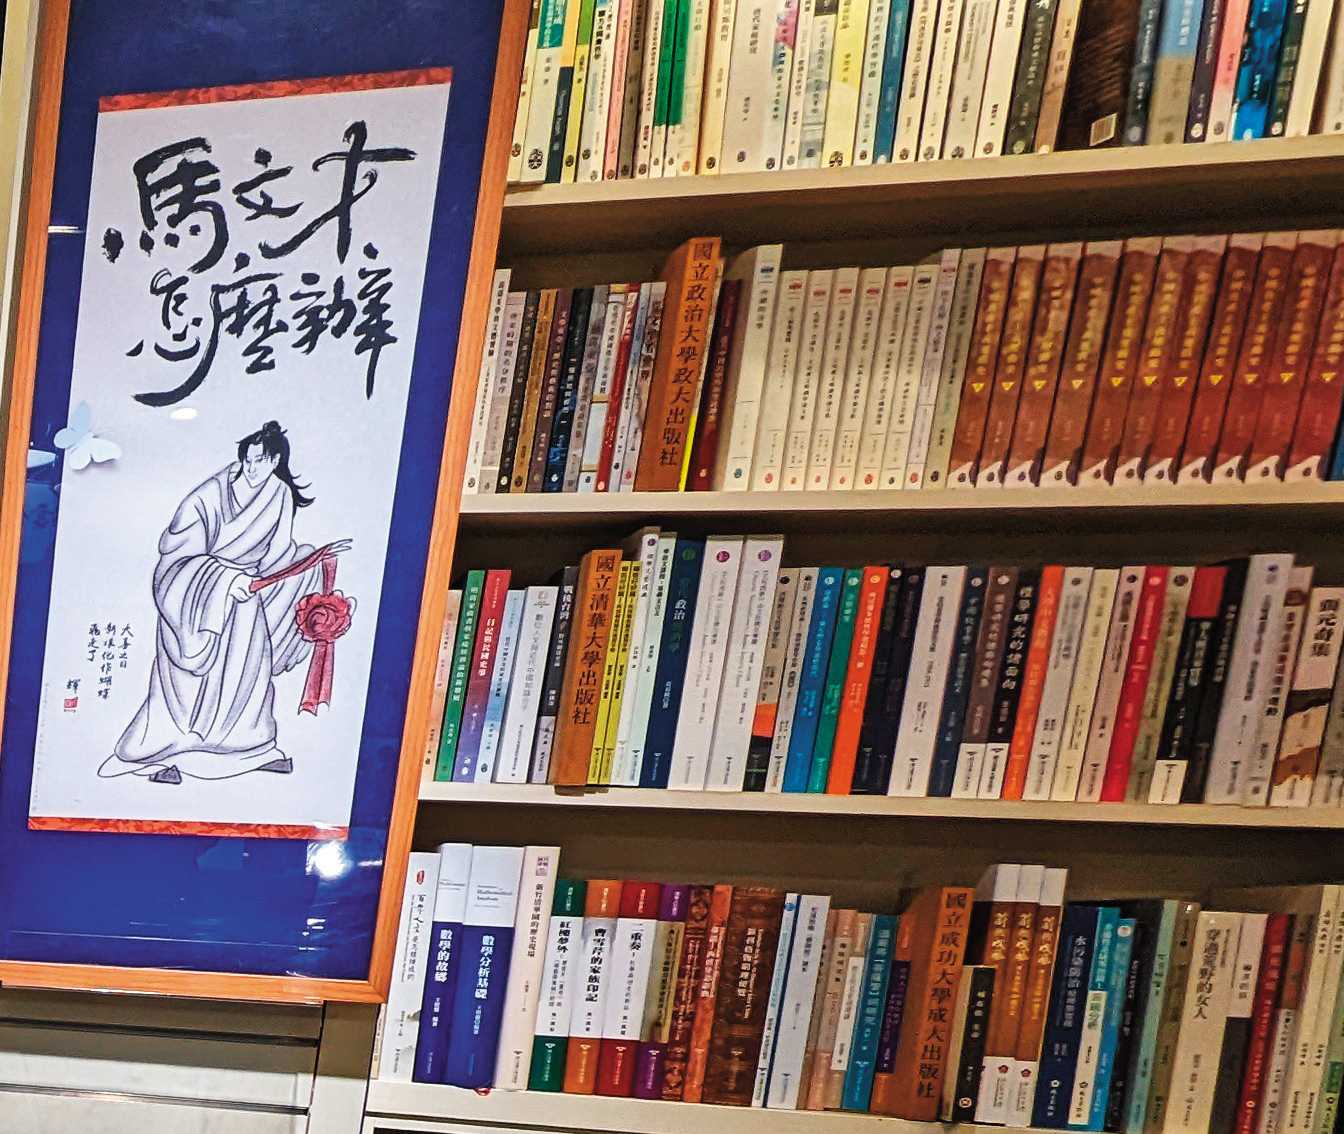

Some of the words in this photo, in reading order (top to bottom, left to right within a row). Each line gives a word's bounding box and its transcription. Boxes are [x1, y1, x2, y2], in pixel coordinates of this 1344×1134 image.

[101, 120, 417, 273] 馬文才
[126, 245, 397, 407] 怎麼辦
[660, 242, 713, 467] 國立政治大學政大出版社
[572, 555, 616, 726] 國立清華大學出版社
[918, 893, 967, 1098] 國立成功大學成大出版社
